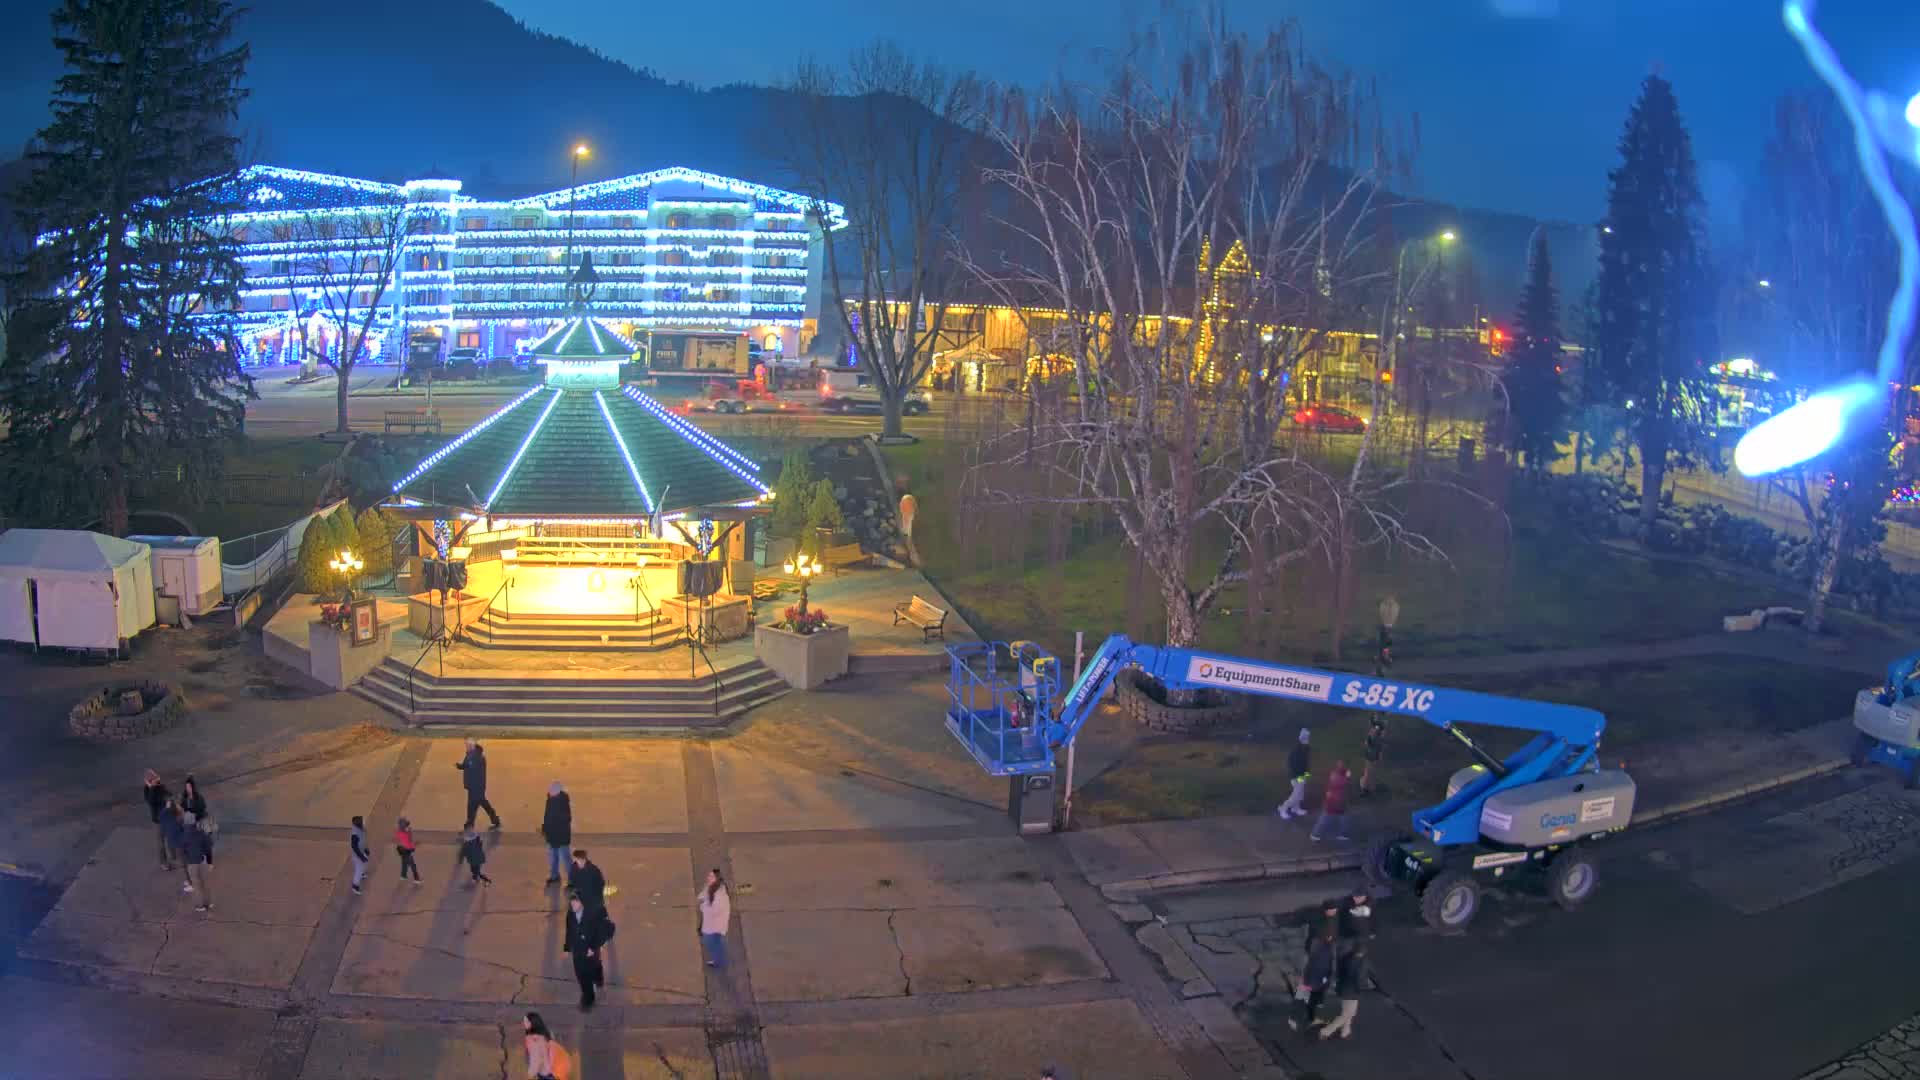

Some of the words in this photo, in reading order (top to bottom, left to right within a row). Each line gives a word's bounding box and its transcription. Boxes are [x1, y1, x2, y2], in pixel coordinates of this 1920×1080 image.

[1215, 667, 1321, 693] EquipmentShare
[1342, 680, 1397, 707] S-85
[1399, 687, 1435, 712] XC
